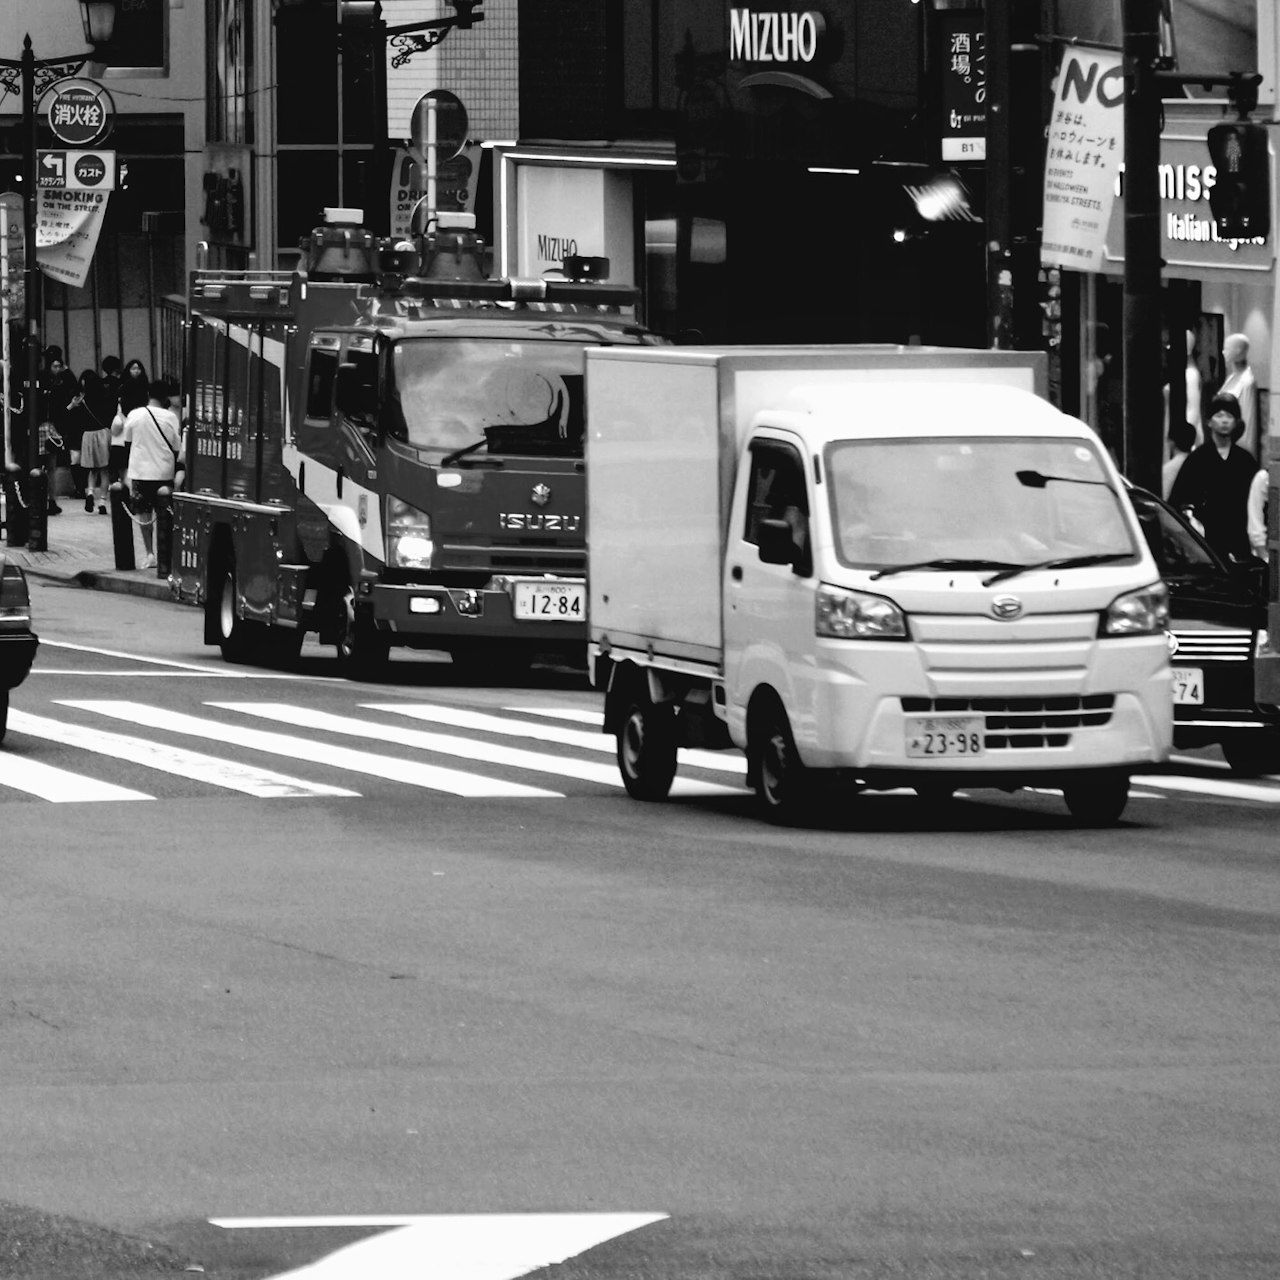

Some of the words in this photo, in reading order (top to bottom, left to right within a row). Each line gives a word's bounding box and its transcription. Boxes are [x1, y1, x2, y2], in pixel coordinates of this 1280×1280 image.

[730, 8, 817, 62] MIZUHO
[55, 104, 100, 126] 消火栓
[962, 143, 974, 153] B1
[43, 189, 104, 204] SMOKING
[57, 202, 72, 210] THE
[1167, 213, 1210, 241] Italian
[537, 234, 578, 262] MIZUHO
[499, 513, 580, 531] ISUZU
[532, 595, 580, 614] 12-84
[924, 733, 981, 754] 23-98
